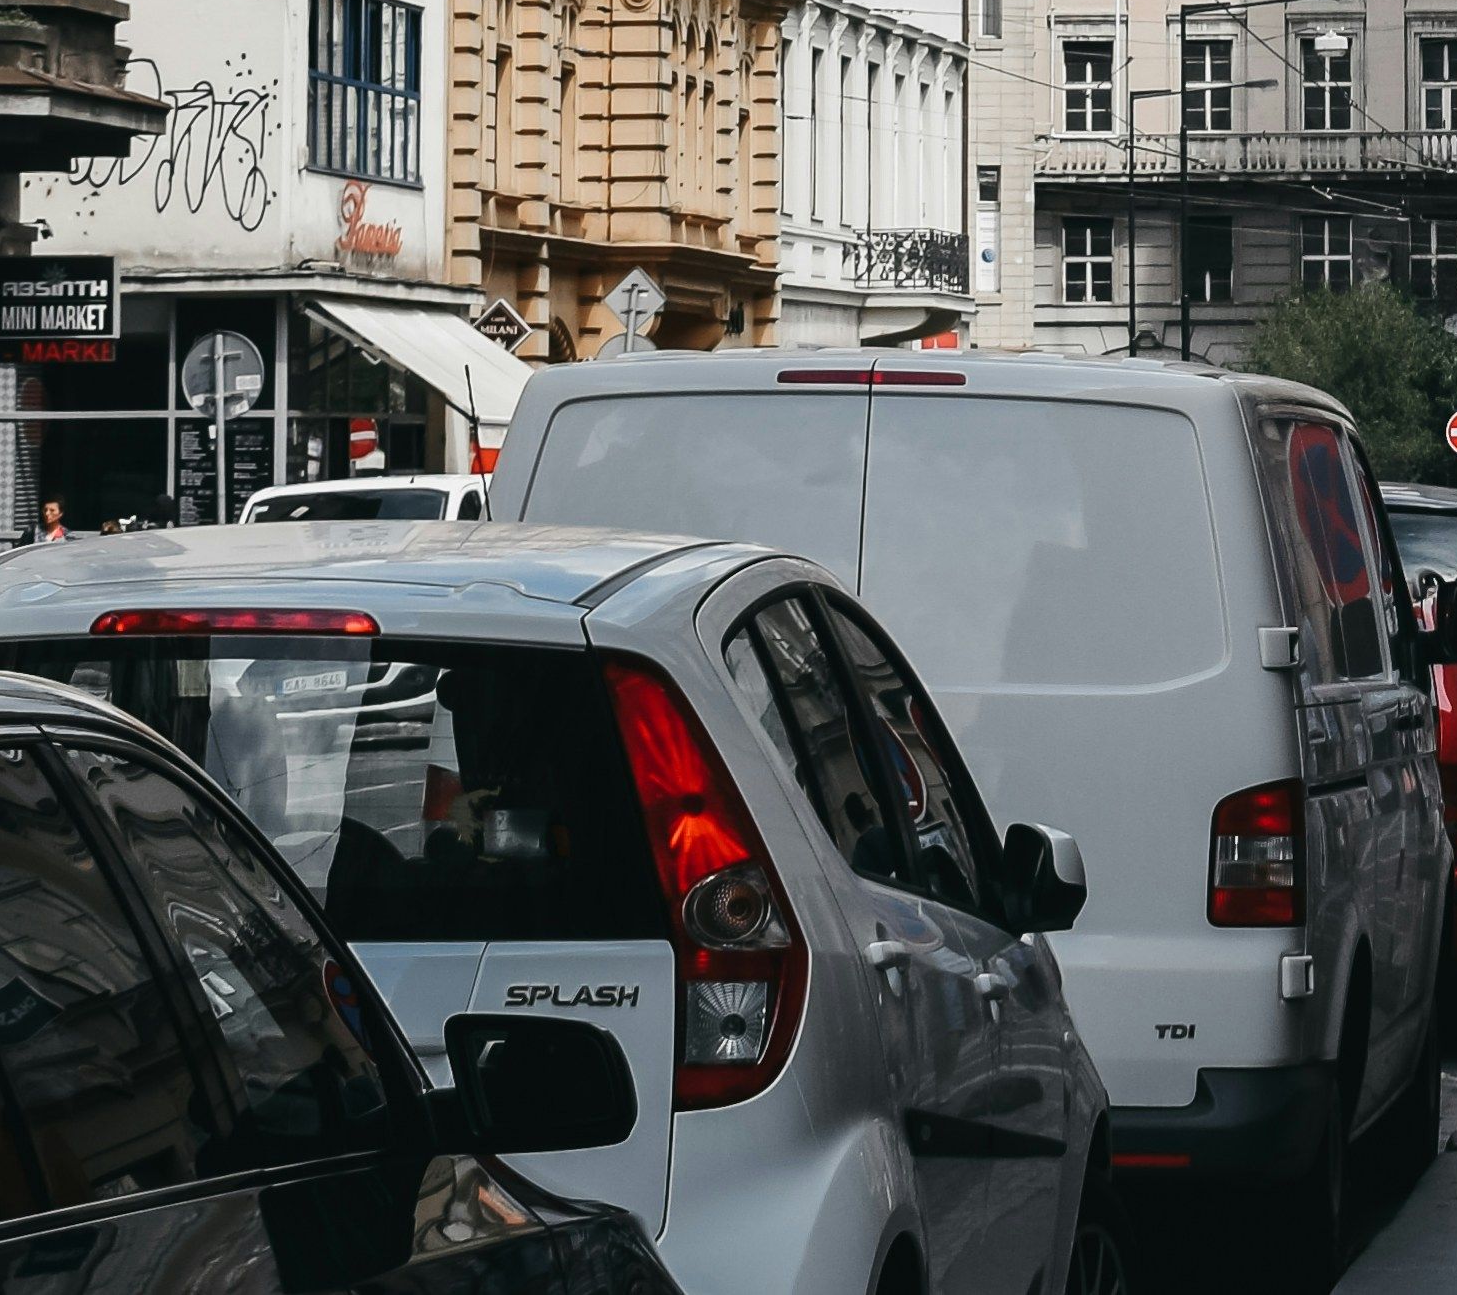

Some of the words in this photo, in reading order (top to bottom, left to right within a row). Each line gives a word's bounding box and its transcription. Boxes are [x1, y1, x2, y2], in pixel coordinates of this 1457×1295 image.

[2, 279, 108, 297] ABSINTH
[1, 305, 37, 331] MINI
[41, 303, 108, 331] MARKET
[504, 984, 640, 1007] SPLASH
[1154, 1023, 1196, 1040] TDI
